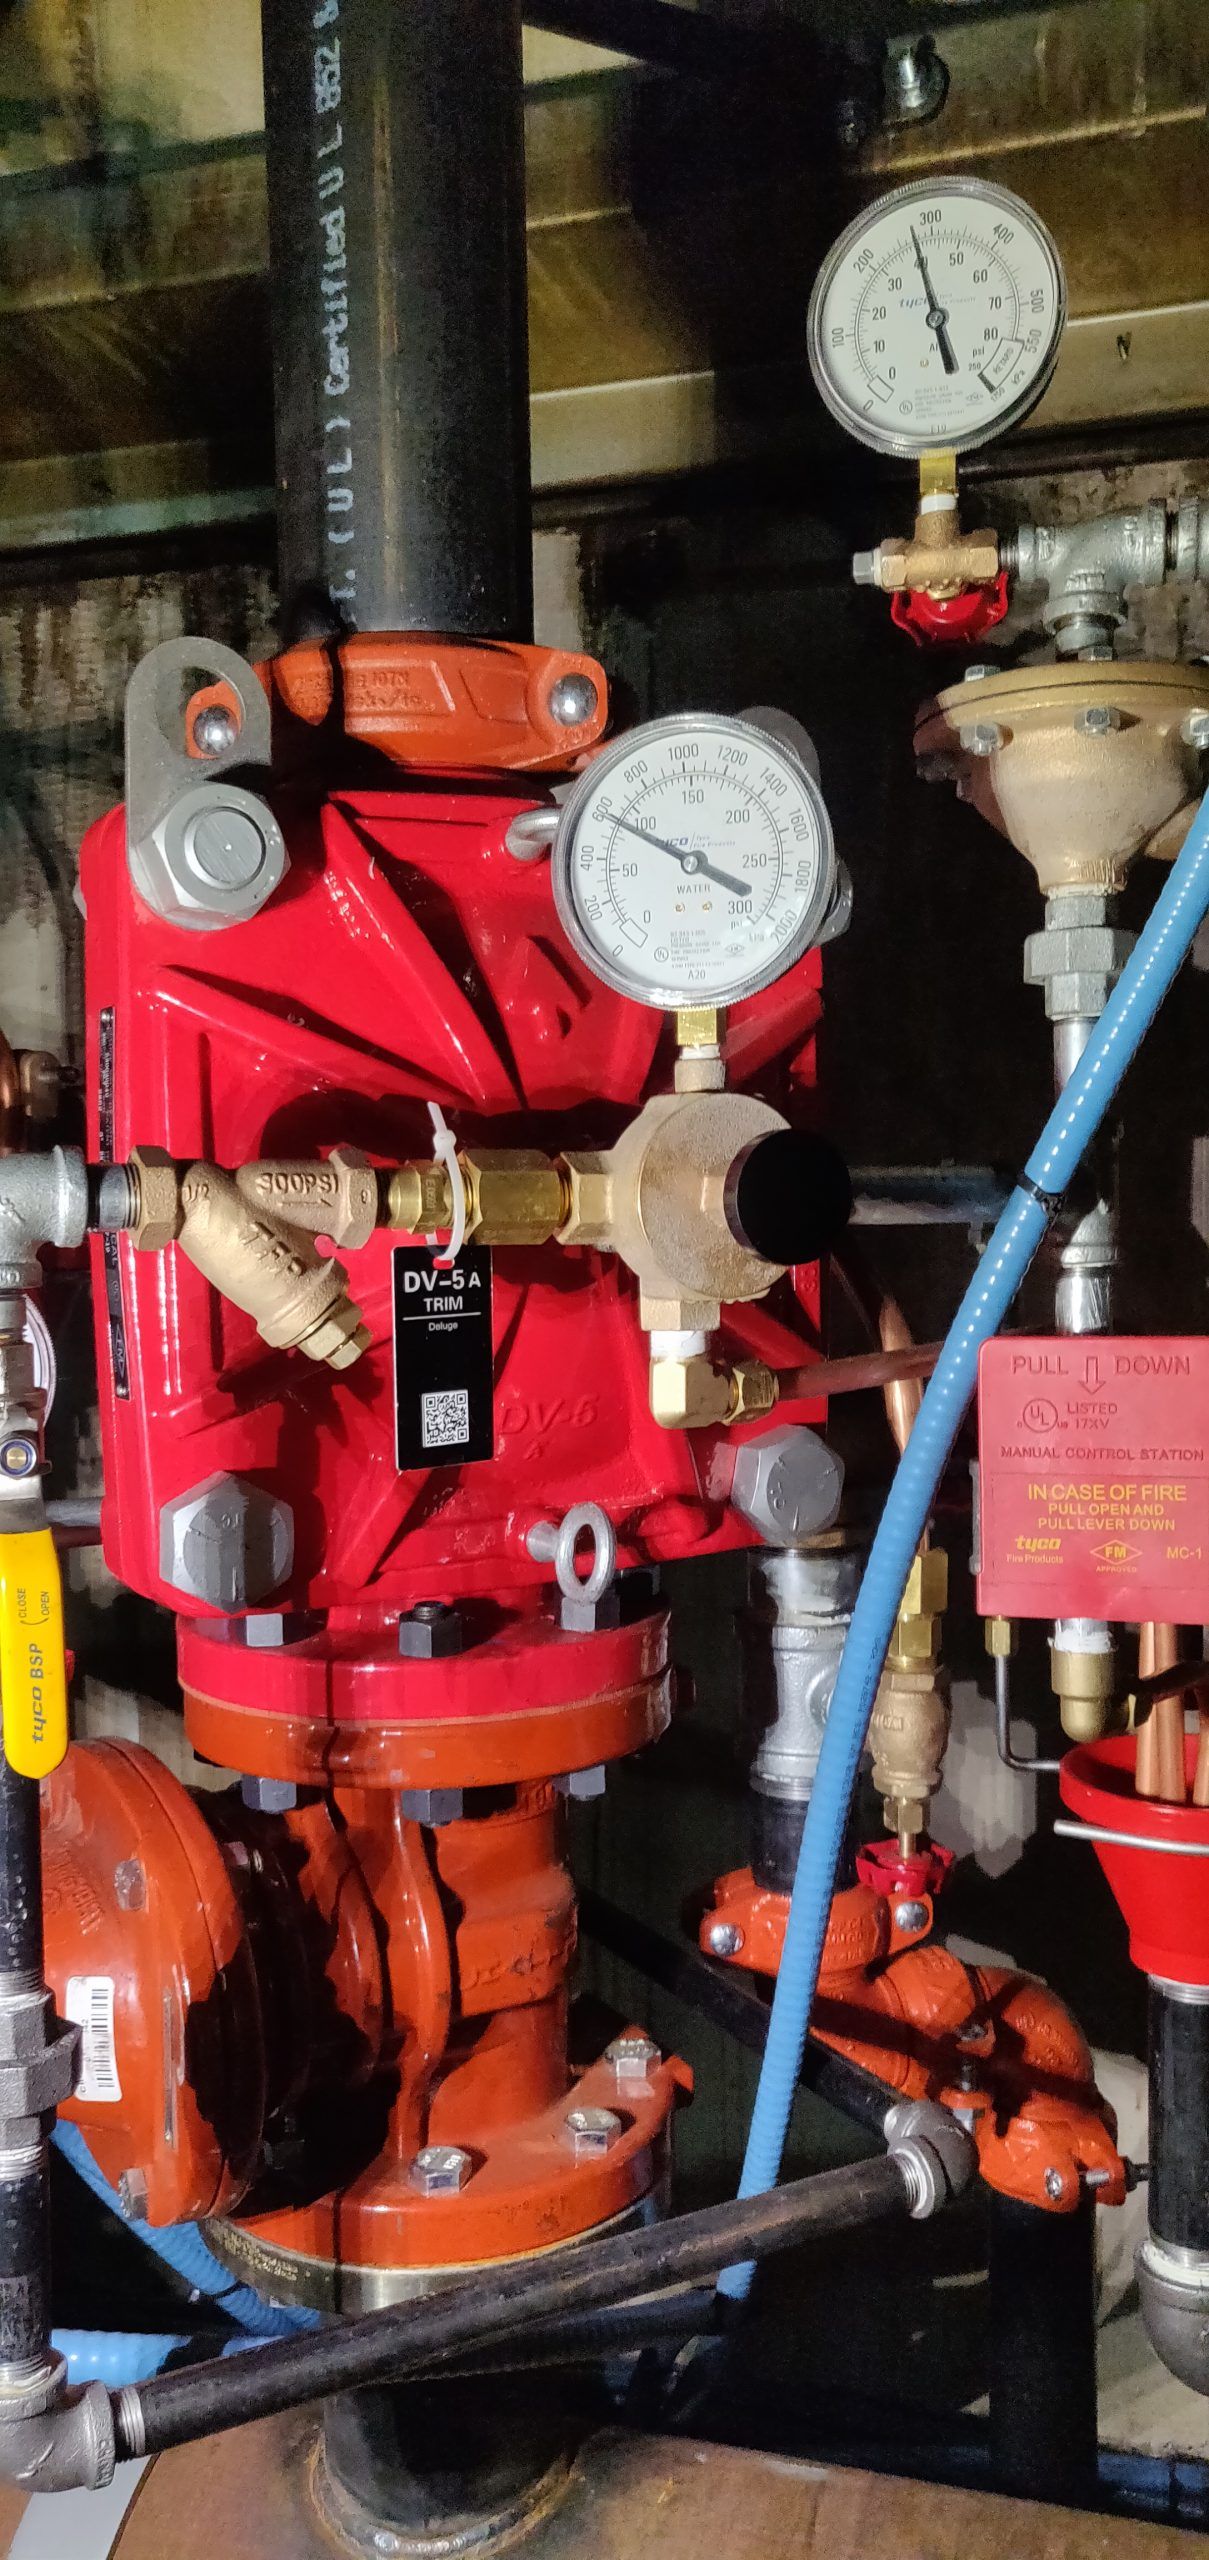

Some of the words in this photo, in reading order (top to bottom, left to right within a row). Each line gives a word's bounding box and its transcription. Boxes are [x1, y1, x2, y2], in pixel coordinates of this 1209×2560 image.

[919, 209, 942, 226] 300
[992, 222, 1015, 245] 400
[853, 248, 875, 274] 200
[949, 252, 964, 266] 50
[888, 276, 902, 292] 30
[973, 269, 988, 284] 60
[320, 206, 350, 395] Certified
[988, 296, 1001, 310] 70
[1030, 288, 1045, 314] 500
[872, 306, 887, 321] 20
[831, 327, 845, 349] 100
[983, 326, 998, 341] 80
[1025, 329, 1042, 354] 550
[874, 339, 885, 354] 10
[972, 345, 985, 358] psi
[888, 366, 896, 381] 0
[863, 398, 874, 412] 0
[667, 743, 700, 762] 1000
[717, 744, 748, 767] 1200
[623, 760, 648, 785] 800
[759, 767, 788, 797] 1400
[681, 789, 705, 805] 150
[591, 796, 613, 823] 600
[725, 809, 750, 825] 200
[635, 816, 657, 831] 100
[789, 808, 810, 842] 1600
[580, 845, 594, 871] 400
[742, 853, 767, 869] 250
[622, 862, 638, 878] 50
[795, 860, 812, 893] 1800
[676, 883, 711, 895] WATER
[584, 896, 603, 922] 200
[728, 900, 753, 916] 300
[643, 910, 651, 924] 0
[769, 908, 797, 945] 2000
[612, 944, 624, 958] 0
[687, 969, 707, 981] A20
[404, 1268, 465, 1293] DV-5
[468, 1271, 482, 1289] A
[423, 1295, 464, 1313] TRIM
[428, 1321, 459, 1332] Deluge
[1011, 1355, 1070, 1375] PULL
[1115, 1355, 1191, 1376] DOWN
[1067, 1402, 1118, 1415] LISTED
[1075, 1418, 1110, 1430] 17XV
[1000, 1446, 1060, 1460] MANUAL
[1065, 1447, 1135, 1461] CONTROL
[1140, 1449, 1205, 1462] STATION
[1028, 1483, 1047, 1500] IN
[1050, 1483, 1106, 1501] CASE
[1110, 1484, 1137, 1501] OF
[1141, 1484, 1187, 1501] FIRE
[1049, 1503, 1085, 1515] PULL
[1089, 1503, 1130, 1516] OPEN
[1133, 1503, 1164, 1516] AND
[1038, 1517, 1075, 1530] PULL
[1078, 1518, 1125, 1530] LEVER
[1130, 1518, 1176, 1531] DOWN
[1015, 1535, 1061, 1552] tyco
[1007, 1553, 1024, 1564] Fire
[1024, 1553, 1064, 1565] Products
[1104, 1546, 1126, 1559] FM
[1166, 1546, 1202, 1559] MC-1
[1095, 1565, 1138, 1573] APPROVED
[17, 1587, 27, 1618] CLOSE
[41, 1591, 51, 1616] OPEN
[29, 1642, 45, 1680] BSP
[32, 1686, 47, 1745] tyco
